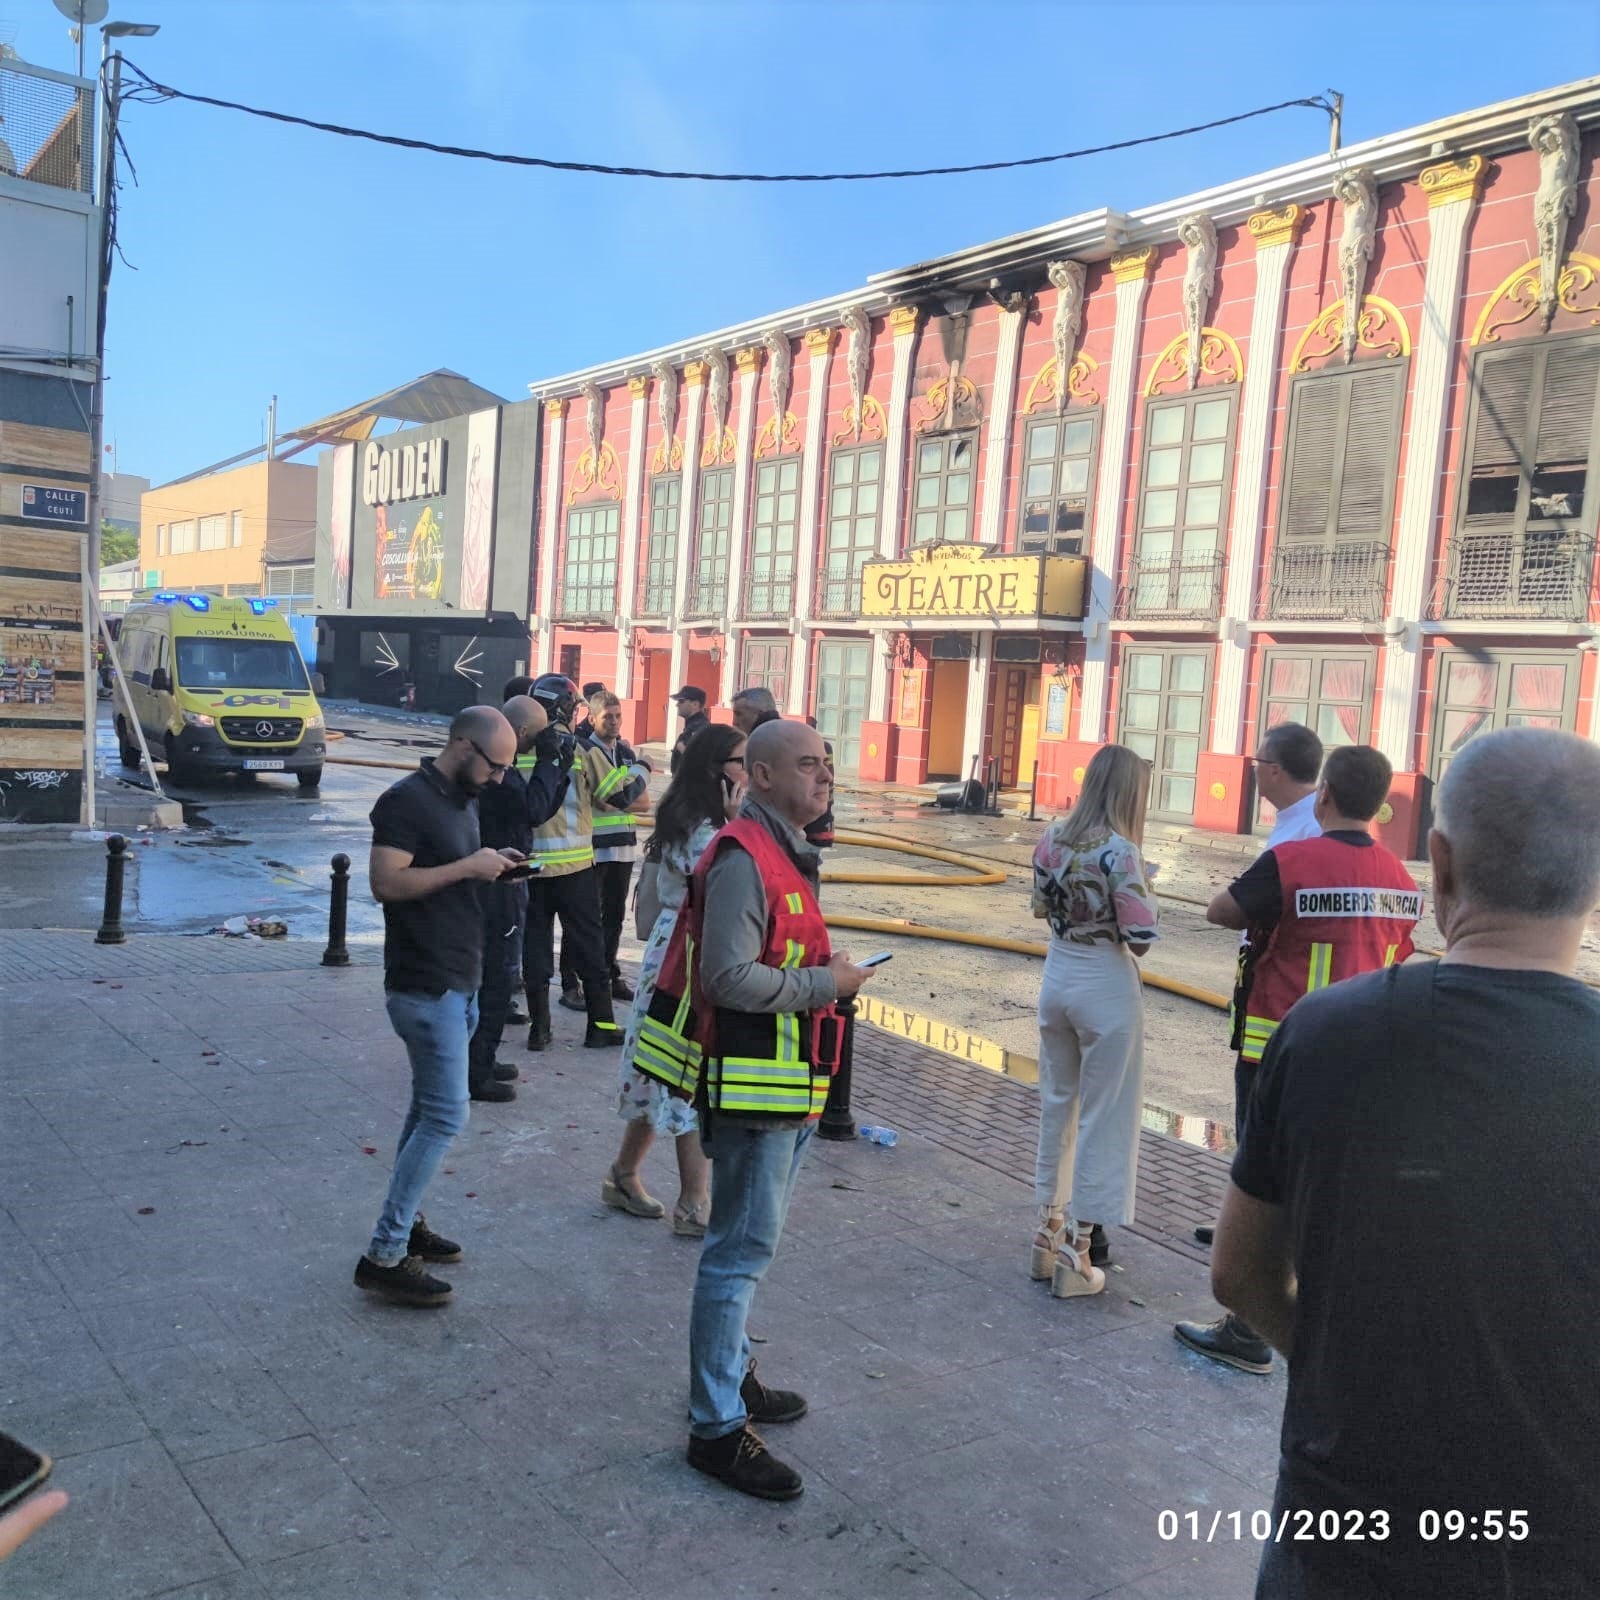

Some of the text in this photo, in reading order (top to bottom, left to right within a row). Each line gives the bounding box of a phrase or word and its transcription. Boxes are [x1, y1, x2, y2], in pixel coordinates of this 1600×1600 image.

[363, 437, 448, 505] GOLDEN
[45, 490, 76, 502] CALLE
[877, 568, 1020, 617] TEATRE
[1299, 892, 1418, 915] BOMBEROS MURCIA
